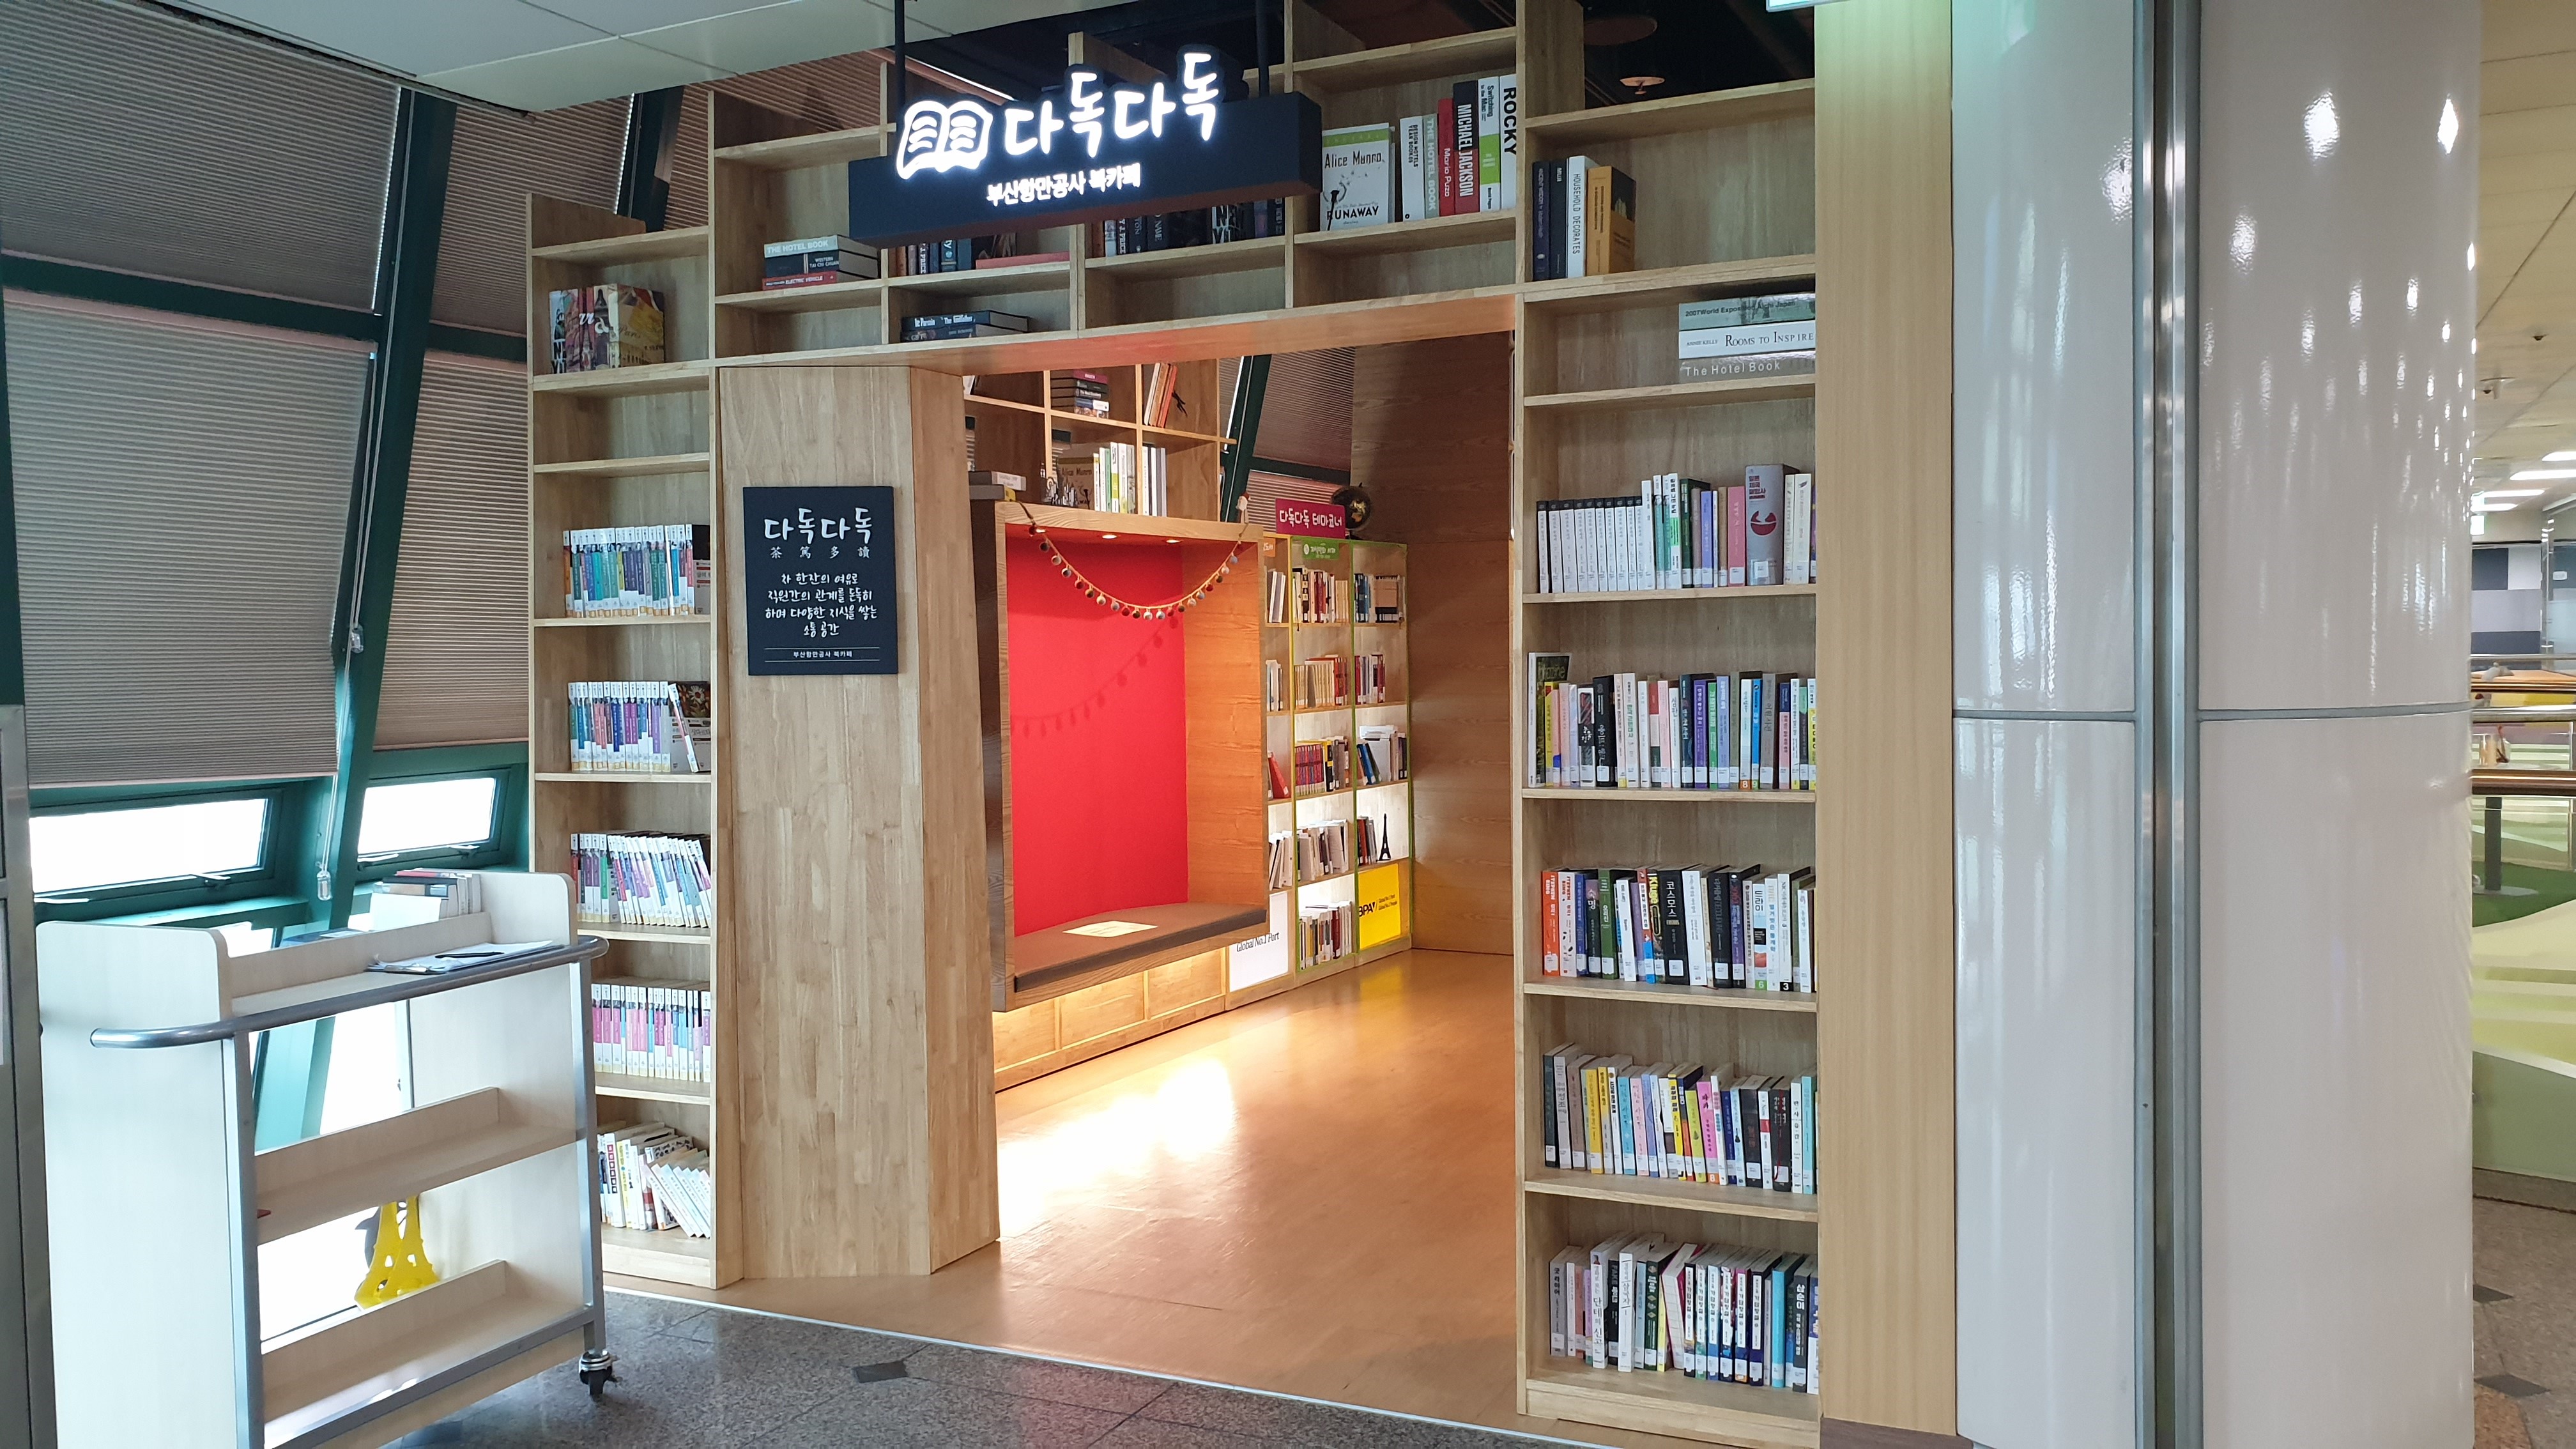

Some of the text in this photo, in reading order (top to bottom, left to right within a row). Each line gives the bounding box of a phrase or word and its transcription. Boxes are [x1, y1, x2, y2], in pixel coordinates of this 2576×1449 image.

[1005, 52, 1219, 157] 다독다독
[1503, 87, 1517, 155] ROCKY
[1324, 150, 1383, 169] Alice Munro
[1458, 103, 1474, 197] MICHAEL JACKSON
[1425, 118, 1436, 210] THE HOTEL BOOK
[987, 163, 1141, 206] 부산항만공사 북카페
[1327, 205, 1379, 220] RUNAWAY
[1572, 173, 1581, 255] HOUSEHOLD DECORATES
[767, 240, 829, 254] THE HOTEL BOOK
[1685, 360, 1781, 376] The Hotel Book
[765, 507, 872, 544] 다독다독
[1279, 508, 1342, 529] 다독다독 테마코너
[781, 572, 859, 585] 차 한잔의 여유로
[768, 587, 872, 603] 직원간의 관계를 돈독히
[765, 604, 877, 620] 하며 다양한 지식을 쌓는
[803, 622, 839, 638] 소통 공간
[1666, 881, 1678, 917] 코스모스
[1236, 932, 1280, 952] Global No.1 Port
